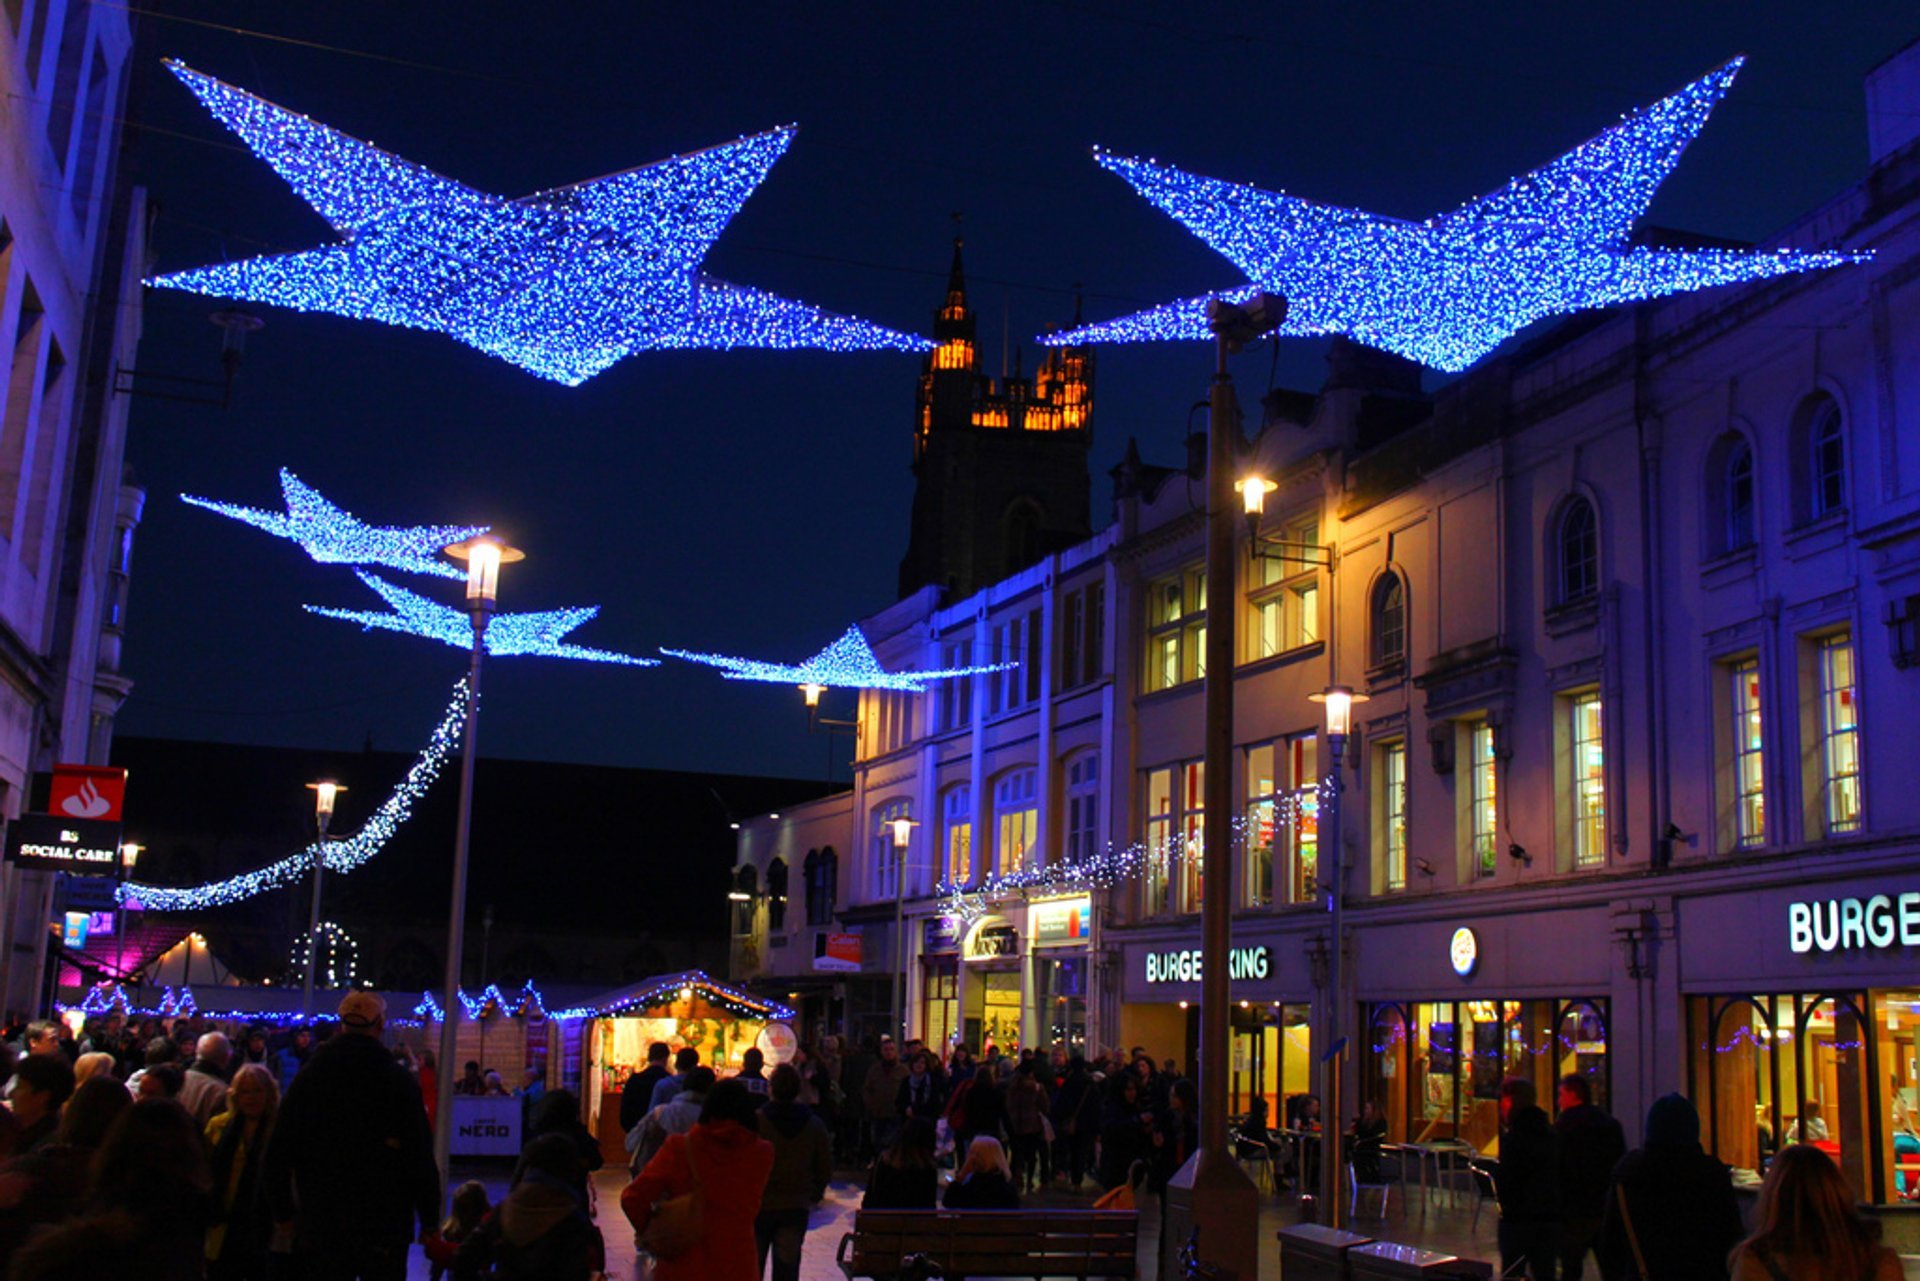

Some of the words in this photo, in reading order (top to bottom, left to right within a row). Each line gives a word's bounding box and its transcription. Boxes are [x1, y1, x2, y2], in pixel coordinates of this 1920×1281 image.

[19, 844, 73, 859] SOCIAL
[75, 849, 114, 862] CARE
[1146, 950, 1203, 982] BURGE
[1229, 946, 1268, 980] KING
[459, 1125, 509, 1137] NERO
